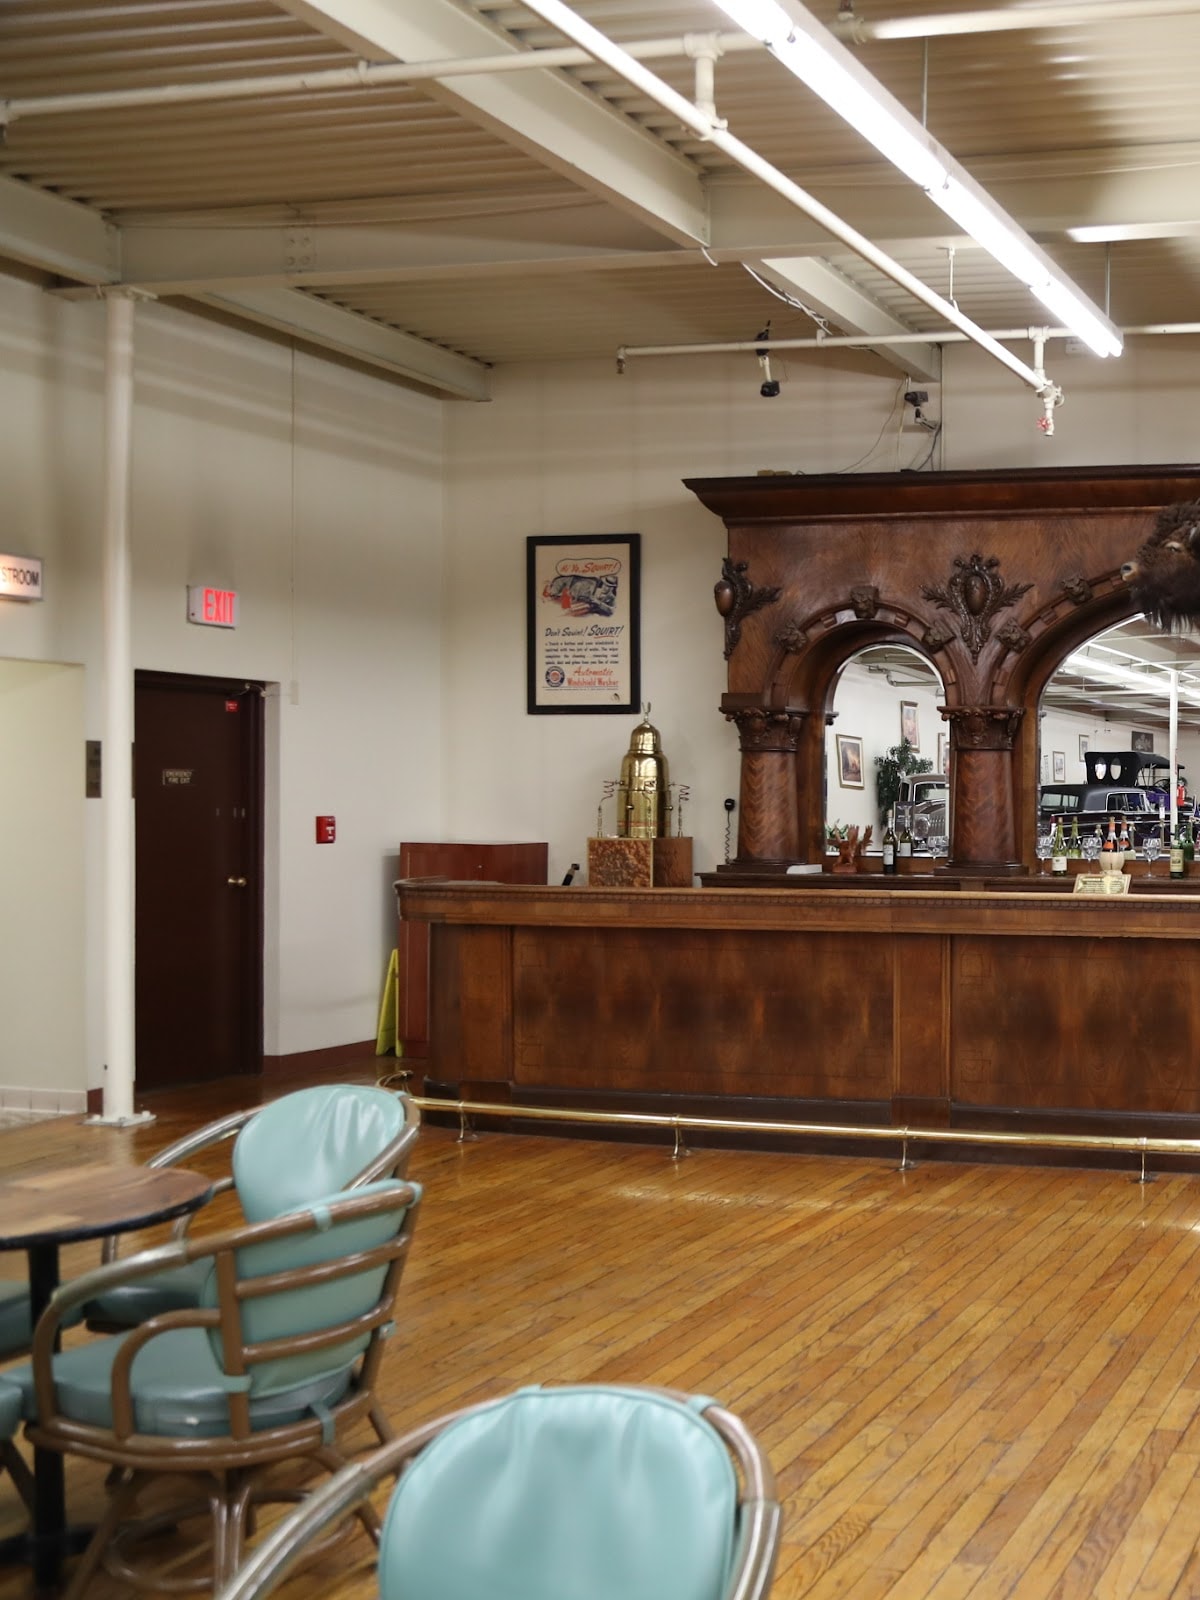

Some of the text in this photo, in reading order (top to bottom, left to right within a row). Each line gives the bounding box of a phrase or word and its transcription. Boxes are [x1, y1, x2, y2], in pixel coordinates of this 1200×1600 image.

[203, 588, 236, 624] EXIT
[588, 625, 624, 638] SQUIRT!
[573, 666, 614, 677] Automatic
